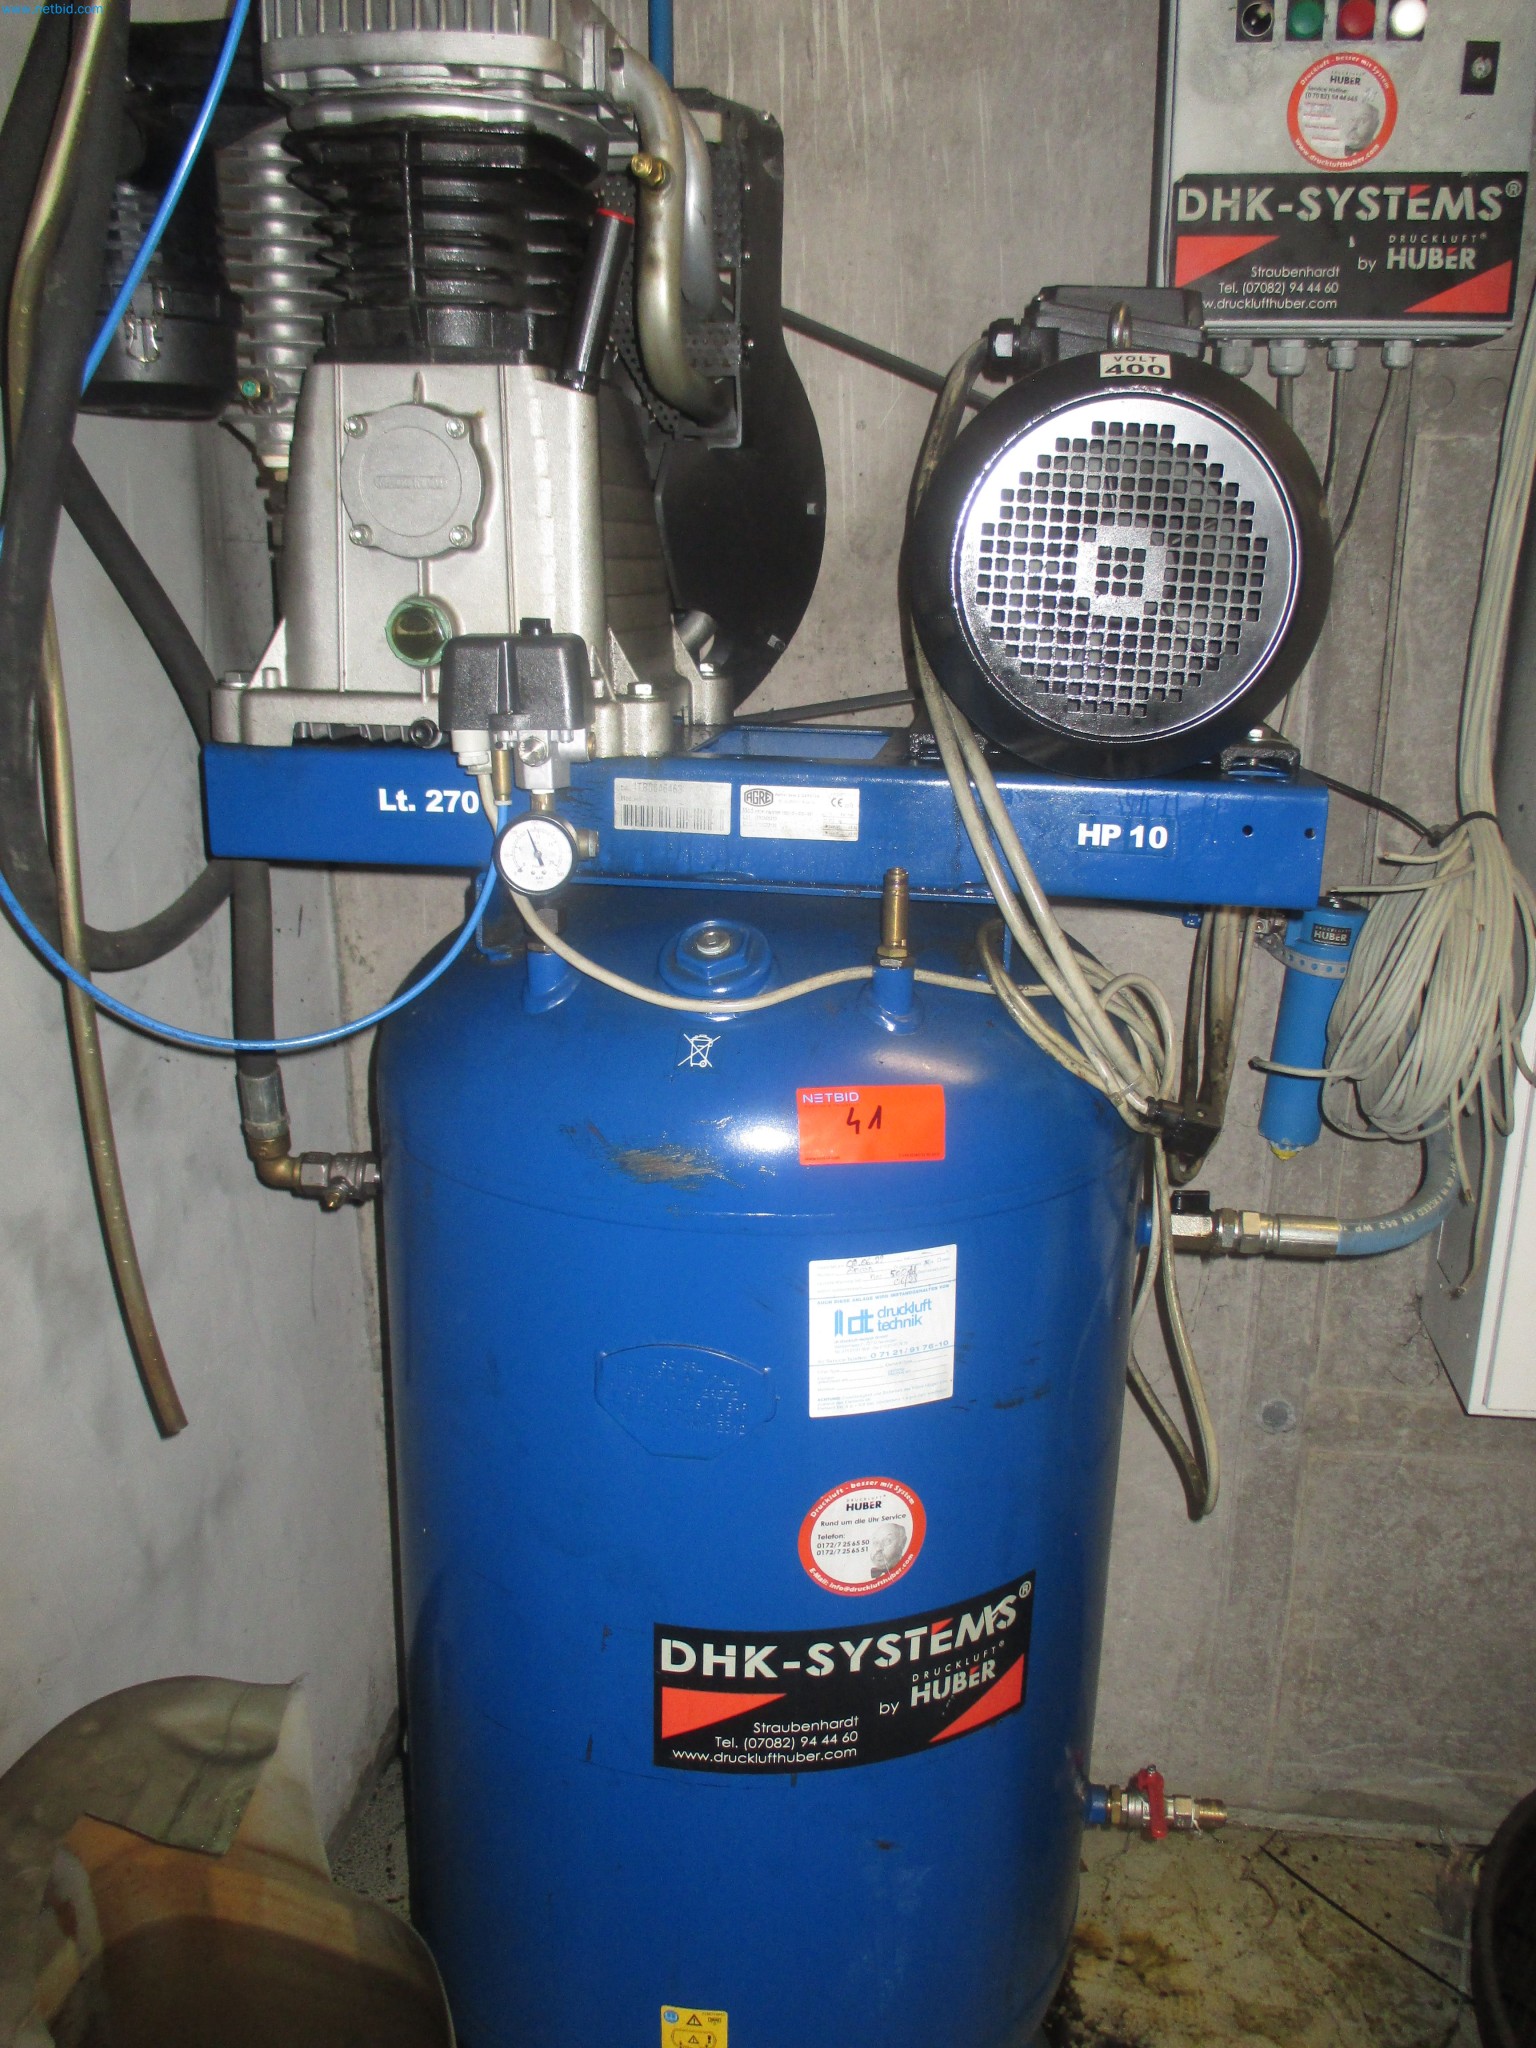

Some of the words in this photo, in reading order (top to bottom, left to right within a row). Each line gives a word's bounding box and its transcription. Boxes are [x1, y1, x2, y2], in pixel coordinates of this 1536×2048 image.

[1300, 60, 1329, 86] Druckluft
[1361, 59, 1372, 68] mit
[1372, 65, 1390, 89] System
[1330, 75, 1361, 85] HUBER
[1357, 256, 1377, 273] by
[1386, 247, 1476, 270] HUBER
[1251, 266, 1340, 278] Straubenhardt
[1218, 283, 1238, 294] Tel.
[1242, 282, 1286, 295] (07082)
[1289, 282, 1303, 294] 94
[1307, 283, 1321, 293] 44
[1324, 282, 1339, 294] 60
[1202, 298, 1338, 310] w.drucklufthuber.com
[1104, 363, 1165, 376] 400
[379, 788, 416, 812] Lt.
[425, 789, 479, 814] 270
[745, 790, 771, 805] AGRE
[1077, 823, 1122, 847] HP
[1129, 825, 1168, 849] 10
[1313, 930, 1348, 942] HUBER
[802, 1091, 859, 1104] NETBID
[1355, 1224, 1374, 1233] WP
[877, 1298, 932, 1319] druckluft
[877, 1314, 923, 1332] technik
[810, 1488, 844, 1518] Druckluft
[850, 1480, 878, 1489] besser
[879, 1480, 893, 1489] mit
[893, 1485, 915, 1505] System
[846, 1500, 882, 1512] HUBER
[881, 1513, 907, 1522] Service
[817, 1533, 846, 1541] Telefon:
[816, 1548, 842, 1556] 0172/7
[817, 1541, 842, 1549] 0172/7
[809, 1567, 829, 1586] E-Mail:
[829, 1553, 914, 1592] info@drucklufthuber.com
[879, 1701, 900, 1716] by
[910, 1659, 996, 1707] HUBER
[753, 1716, 859, 1734] Straubenhardt
[715, 1736, 738, 1749] Tel.
[743, 1736, 795, 1750] (07082)
[800, 1735, 817, 1747] 94
[821, 1734, 837, 1745] 44
[842, 1730, 858, 1743] 60
[672, 1747, 857, 1764] www.drucklufthuber.com
